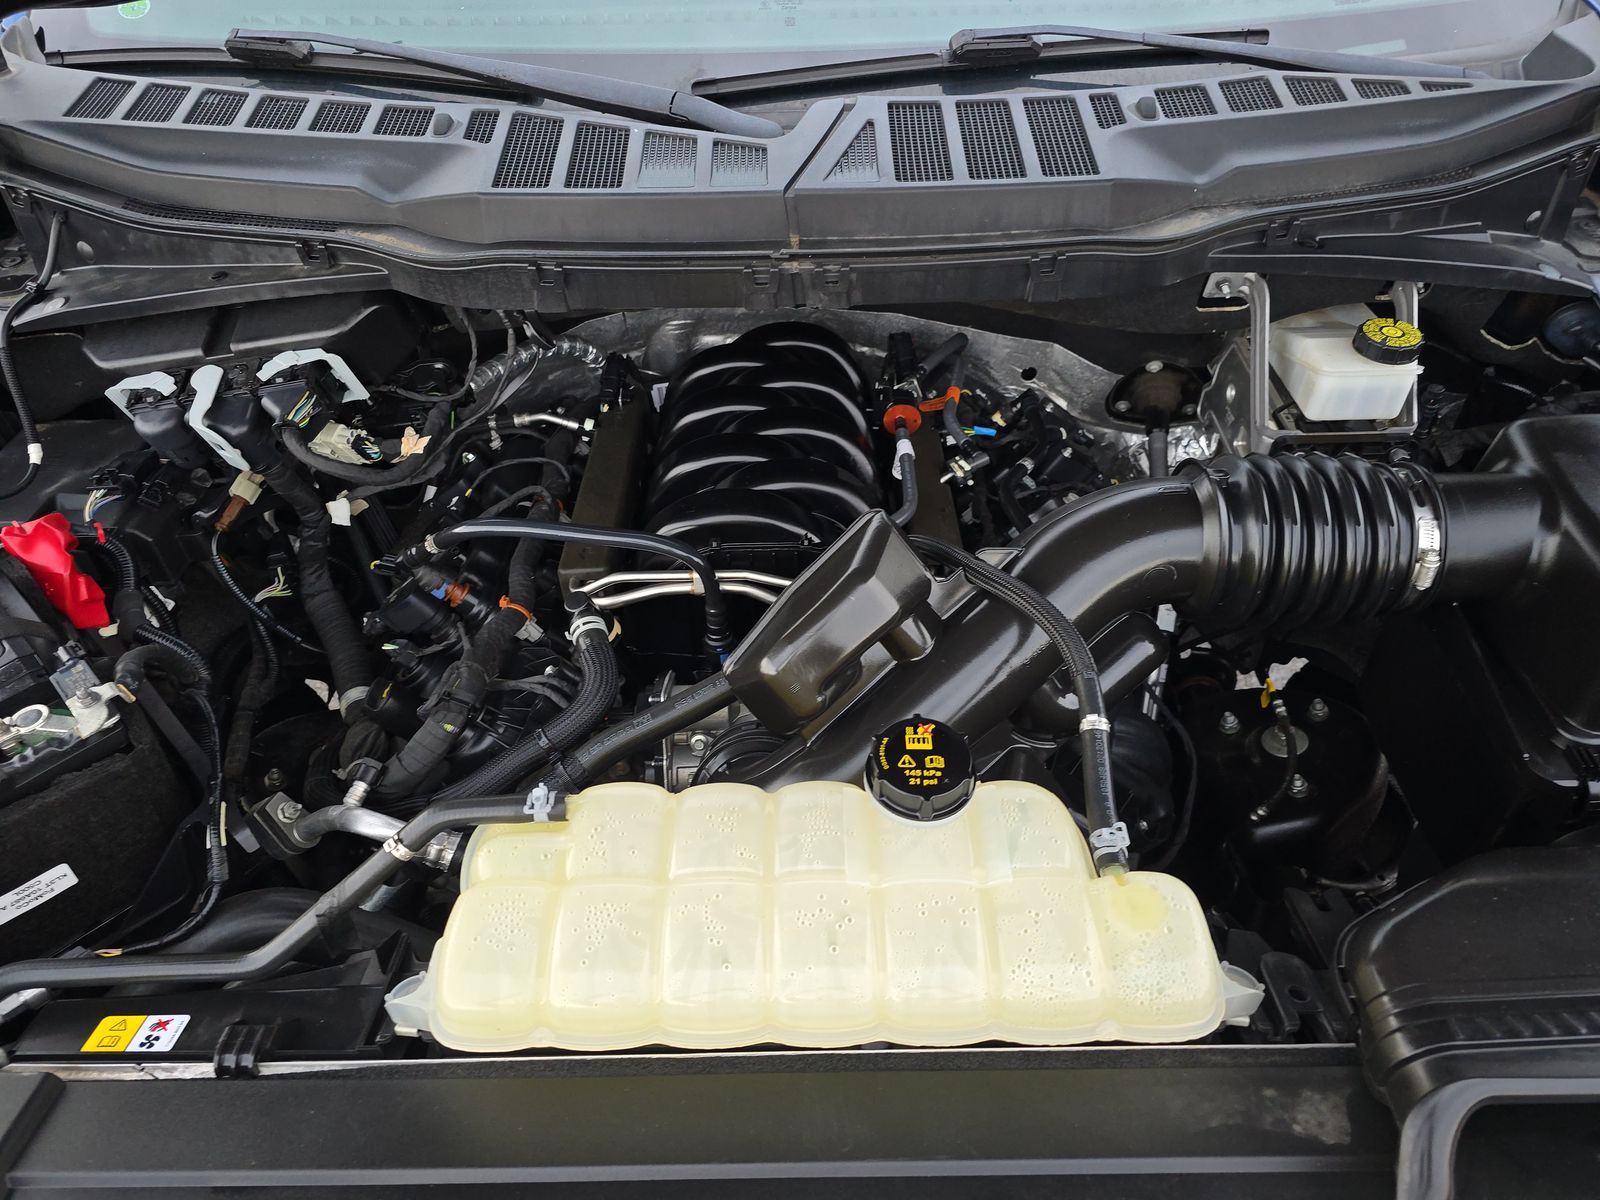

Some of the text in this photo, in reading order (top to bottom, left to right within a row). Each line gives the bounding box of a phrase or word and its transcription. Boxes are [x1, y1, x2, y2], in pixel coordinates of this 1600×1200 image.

[904, 769, 942, 777] 145 kPa
[923, 778, 938, 786] psi
